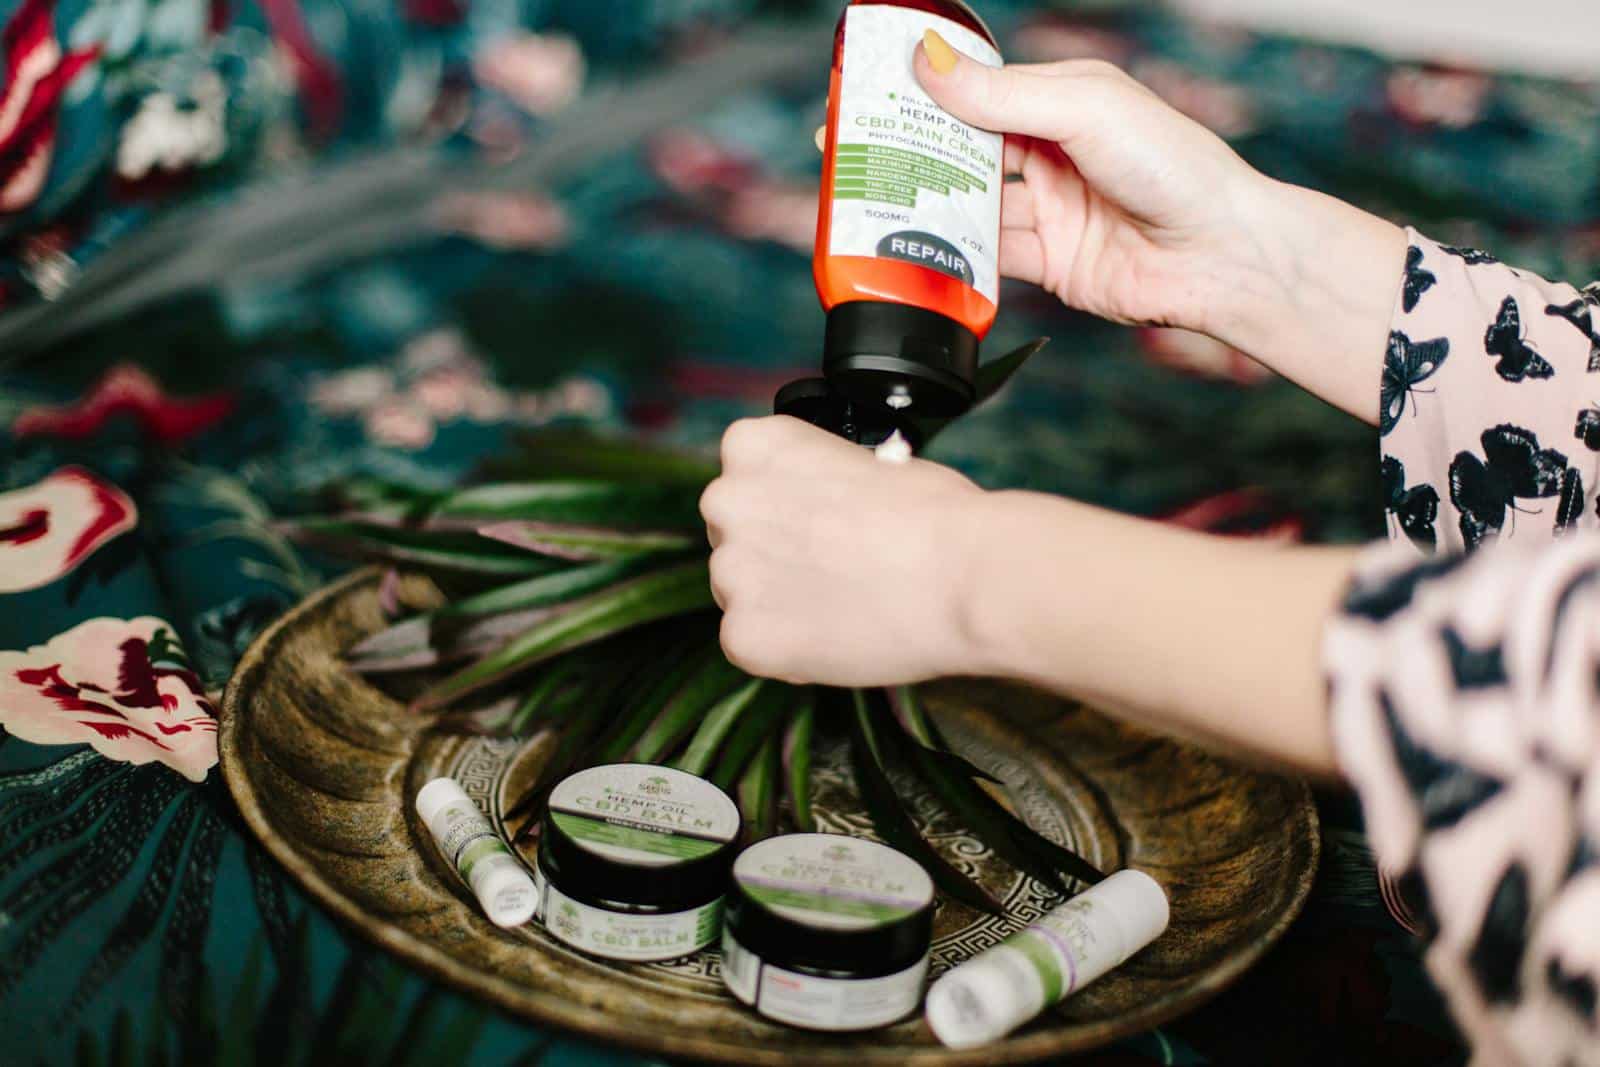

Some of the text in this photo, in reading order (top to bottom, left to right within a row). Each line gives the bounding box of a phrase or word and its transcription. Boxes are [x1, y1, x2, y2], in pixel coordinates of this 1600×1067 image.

[900, 106, 975, 141] HEMP OIL
[855, 115, 997, 172] CBD PAIN CREAM
[866, 158, 912, 171] MAXIMUM
[865, 208, 911, 223] 500MG
[890, 237, 966, 274] REPAIR
[575, 796, 631, 813] CBD
[641, 809, 713, 829] BALM
[607, 794, 657, 809] HEMP
[591, 930, 688, 948] CBD BALM
